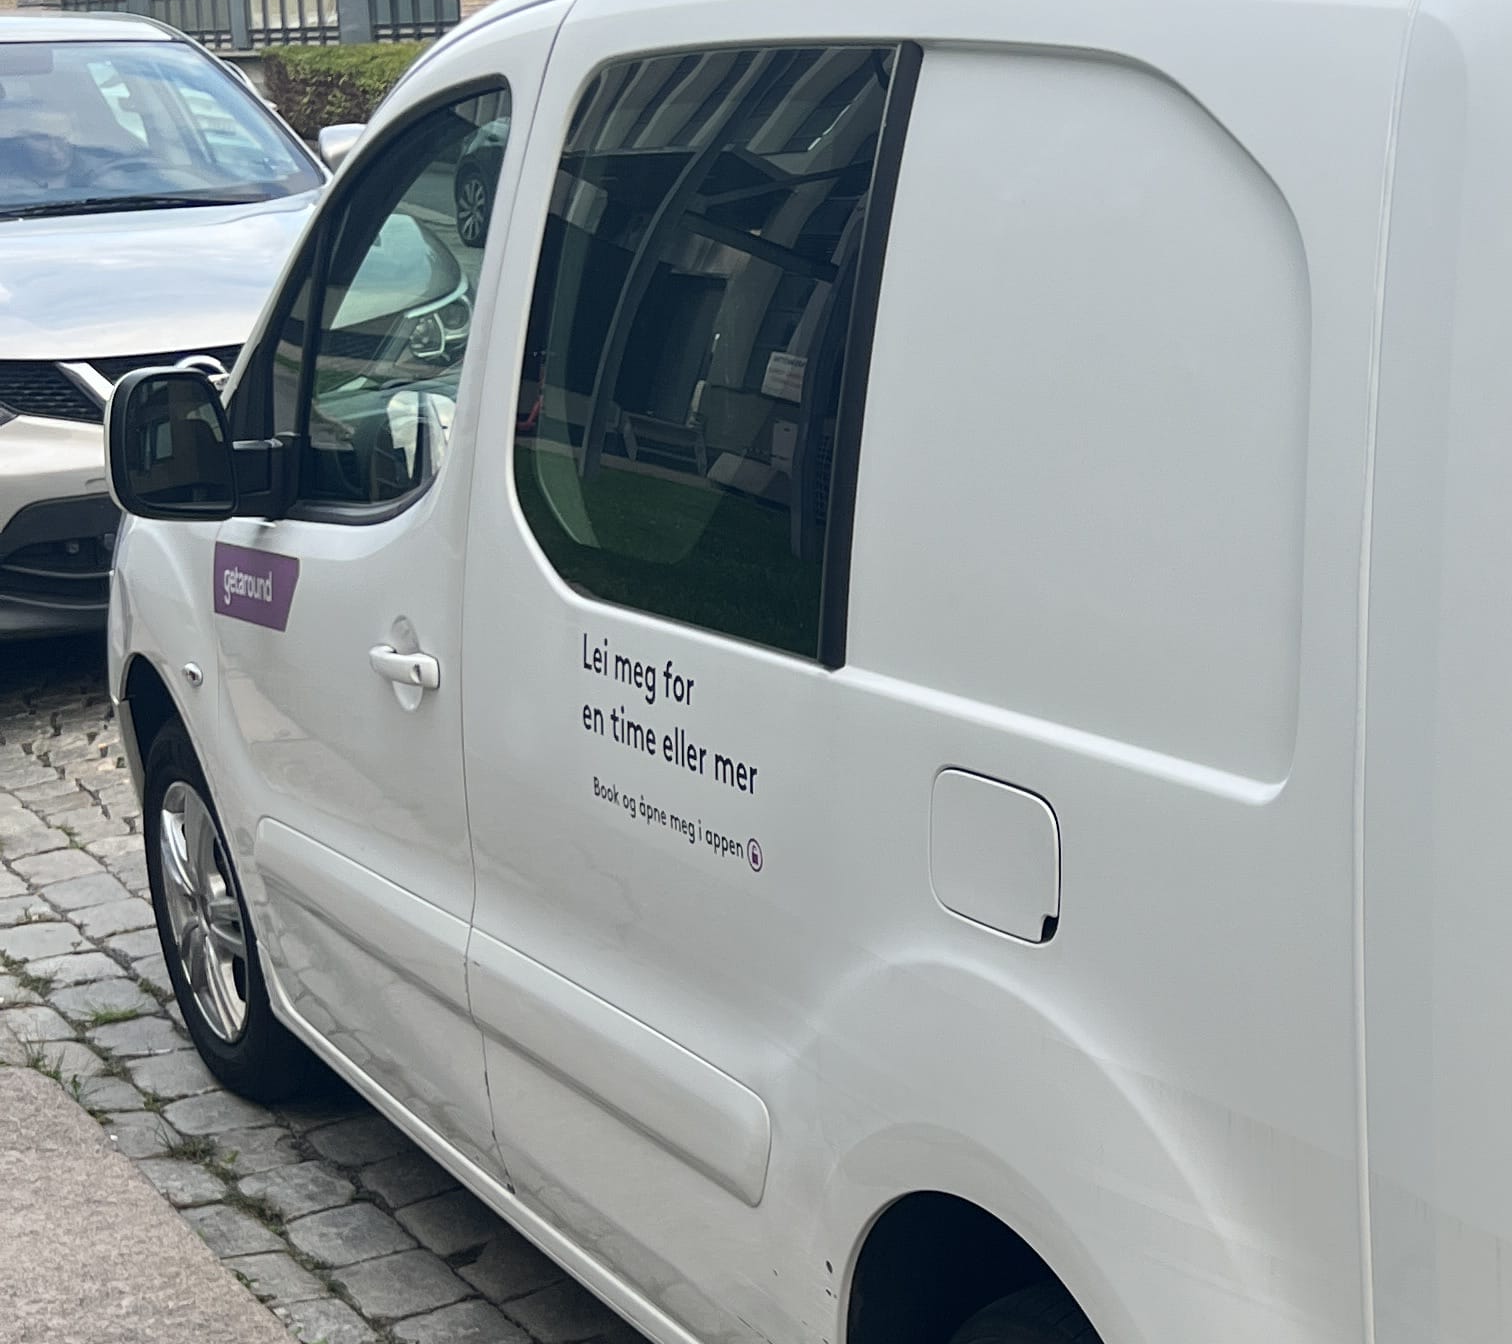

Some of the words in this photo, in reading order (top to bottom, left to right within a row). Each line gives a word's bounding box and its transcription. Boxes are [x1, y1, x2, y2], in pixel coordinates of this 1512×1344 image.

[223, 566, 273, 606] getaround
[583, 632, 608, 676] Lei
[615, 654, 656, 705] meg
[663, 660, 694, 706] for
[582, 704, 604, 736] en
[610, 705, 656, 756] time
[663, 726, 707, 775] eller
[714, 752, 758, 795] mer
[593, 776, 620, 805] Book
[623, 793, 637, 819] og
[639, 795, 667, 826] åpne
[670, 813, 695, 844] meg
[705, 827, 744, 859] appen
